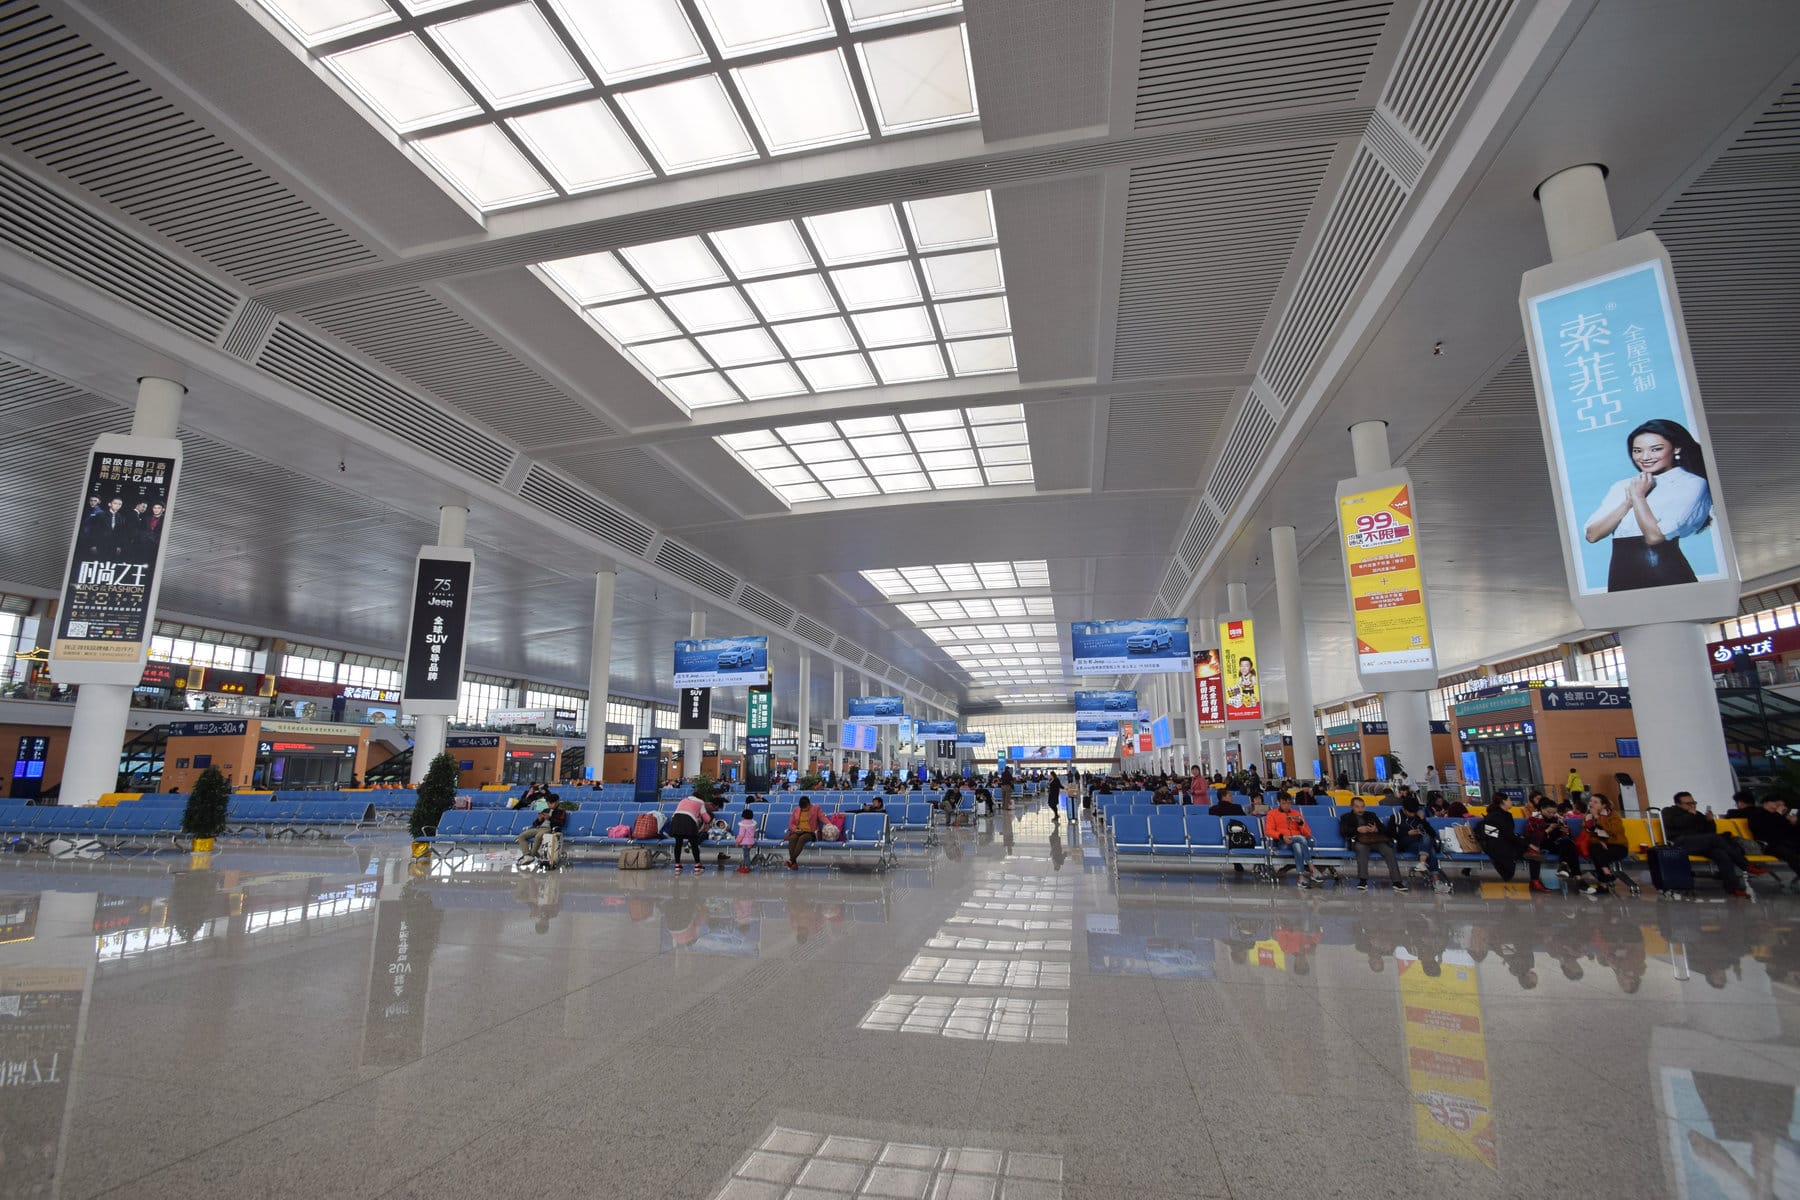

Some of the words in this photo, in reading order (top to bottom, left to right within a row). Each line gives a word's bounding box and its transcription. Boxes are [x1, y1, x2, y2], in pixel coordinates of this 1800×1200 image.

[1622, 325, 1656, 393] 全屋定制
[1356, 512, 1393, 533] 99
[1364, 525, 1410, 542] 不限量
[77, 560, 149, 587] 时尚之王
[107, 586, 145, 594] FASHION
[433, 578, 452, 591] 75
[427, 596, 454, 608] Jeep
[1564, 691, 1595, 701] 检票口
[1598, 690, 1633, 706] 2B-
[208, 722, 237, 734] 2A-30A
[260, 742, 271, 752] 2A
